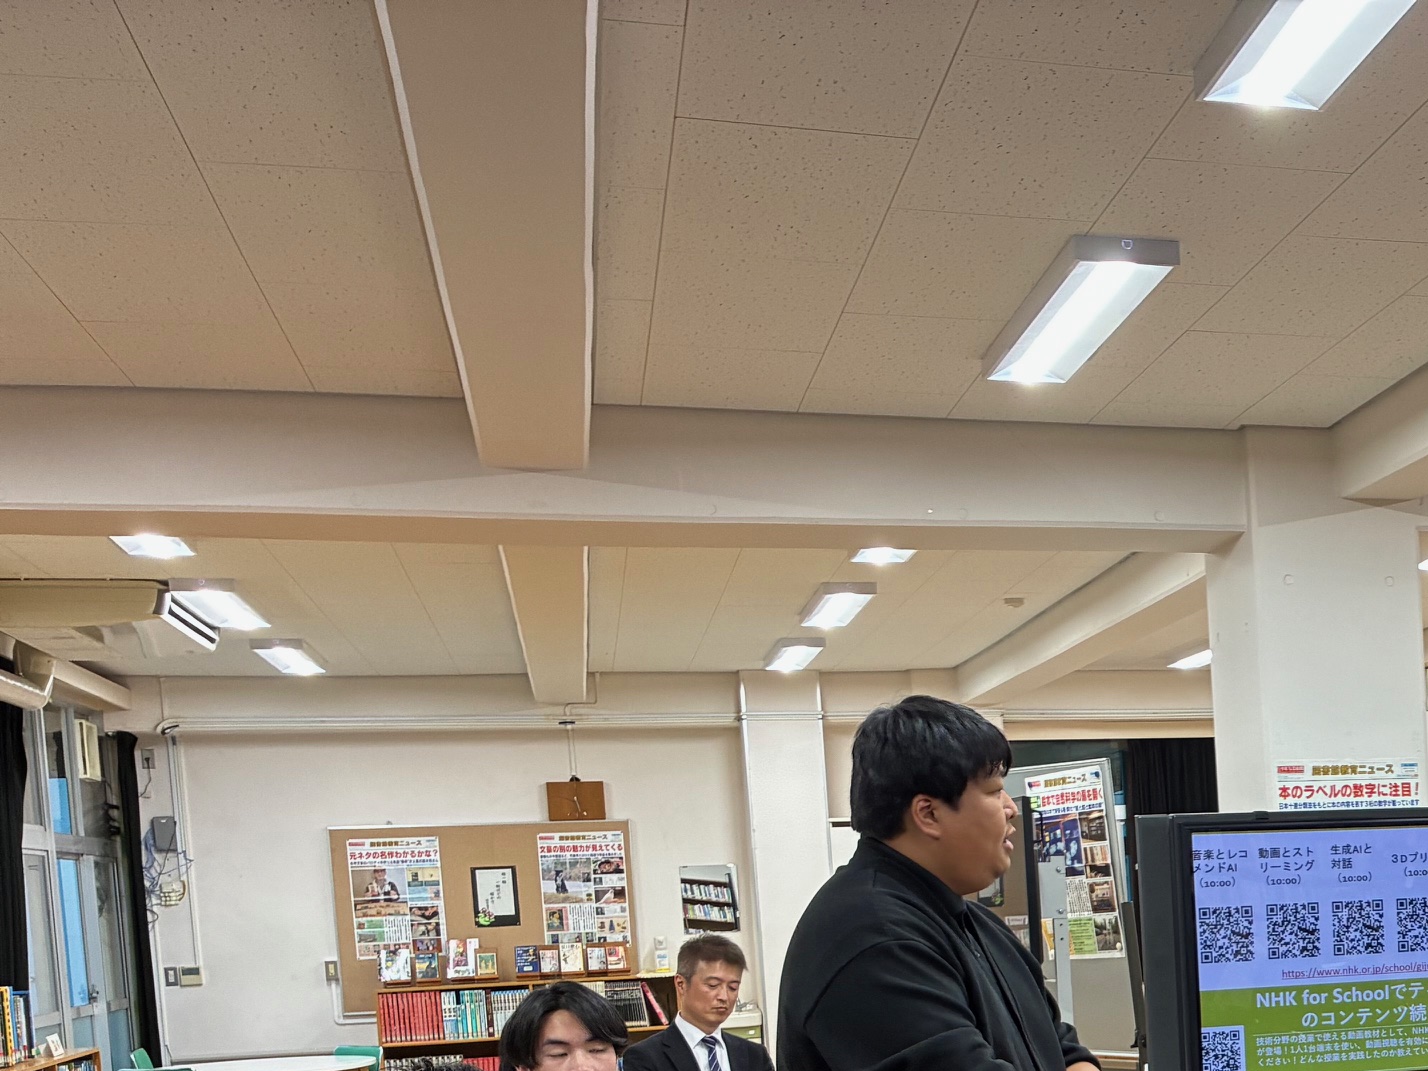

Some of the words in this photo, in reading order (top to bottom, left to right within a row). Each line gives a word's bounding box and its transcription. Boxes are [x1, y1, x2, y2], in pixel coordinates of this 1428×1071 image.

[1278, 782, 1420, 800] 本のラベルの数字に注目！
[349, 849, 438, 860] 元ネタの名作わかるかな？
[1192, 849, 1248, 861] 音楽とレコ
[1258, 846, 1314, 859] 動画とスト
[1330, 843, 1372, 856] 生成AIと
[1192, 862, 1238, 874] メンドAI
[1260, 859, 1315, 873] リーミング
[1330, 858, 1353, 870] 対話
[1256, 990, 1298, 1008] NHK
[1302, 988, 1328, 1006] for
